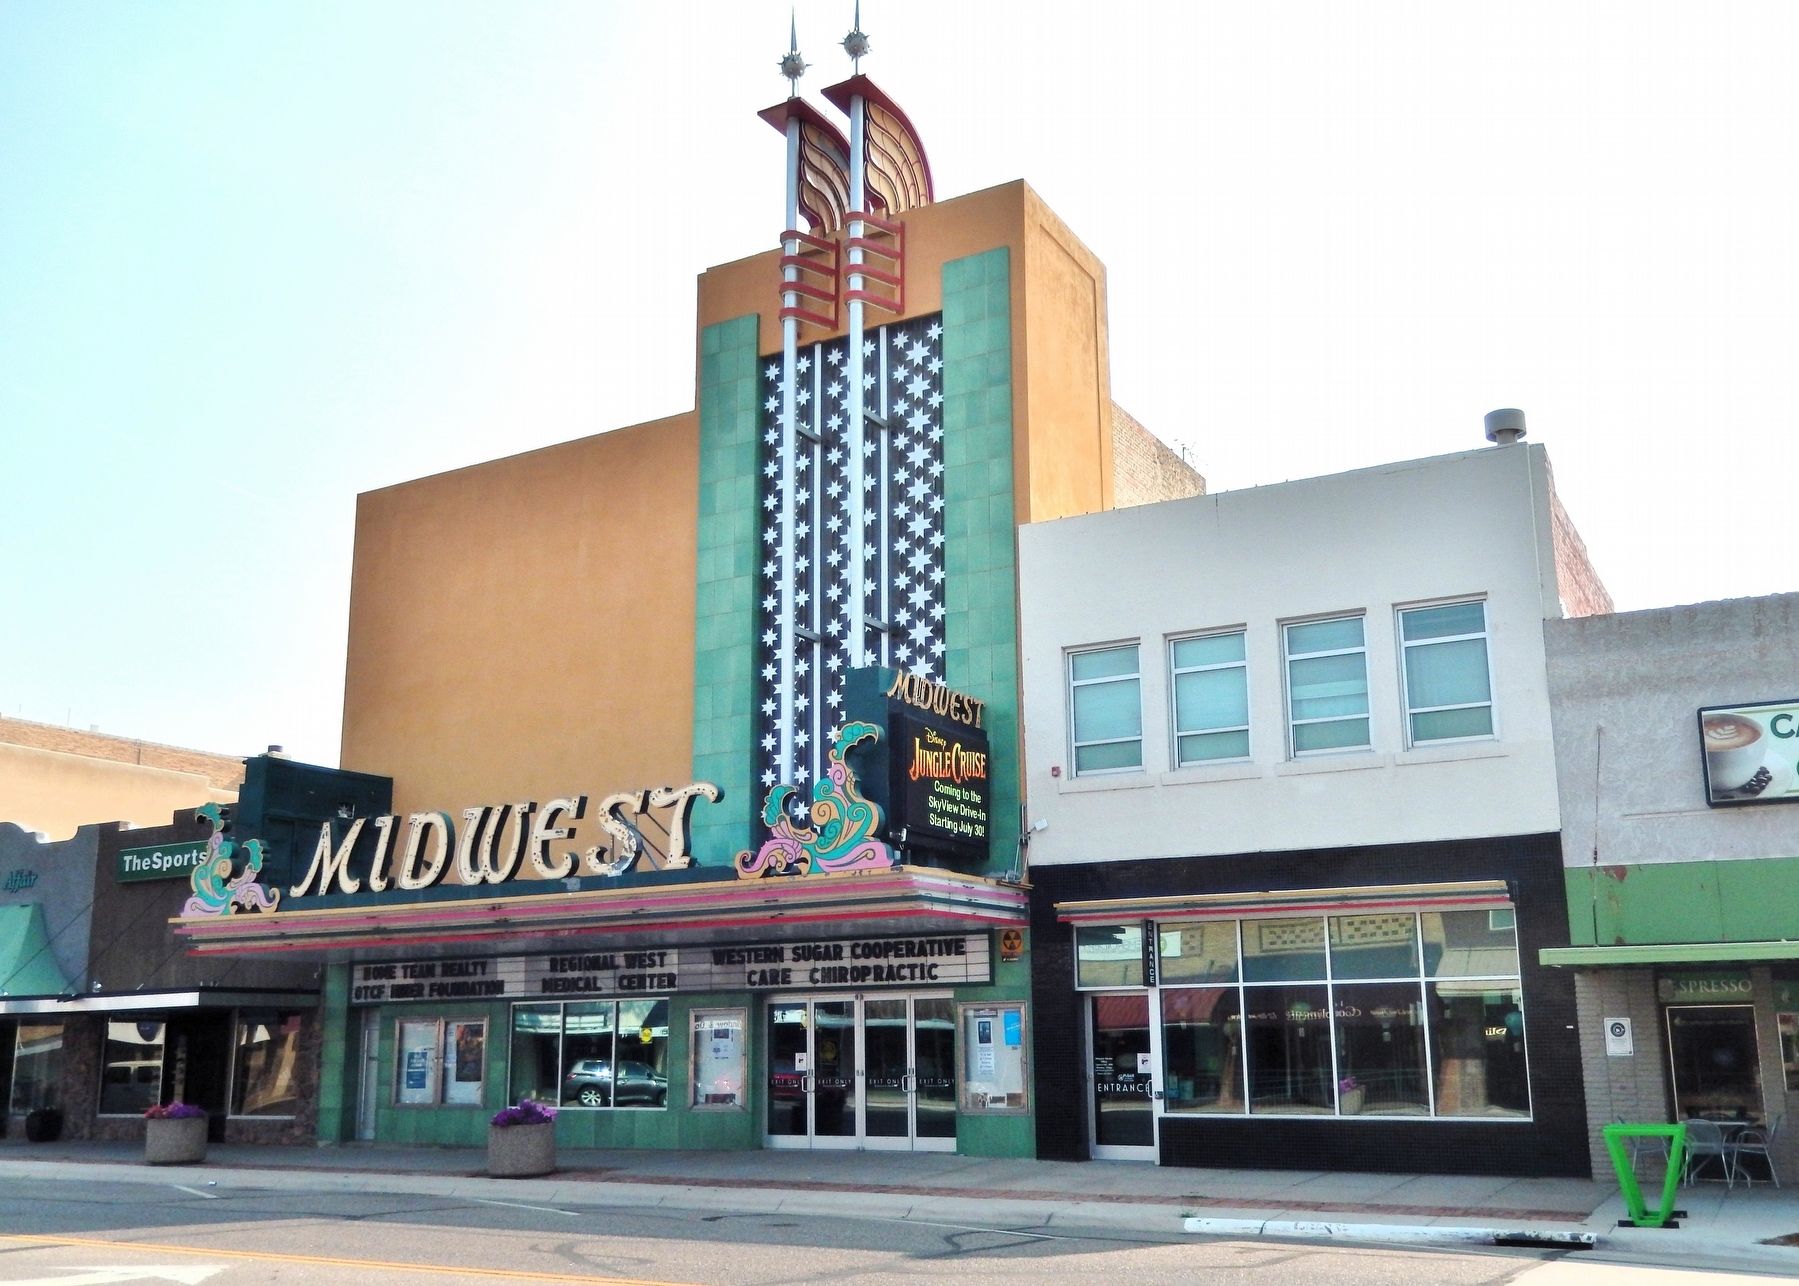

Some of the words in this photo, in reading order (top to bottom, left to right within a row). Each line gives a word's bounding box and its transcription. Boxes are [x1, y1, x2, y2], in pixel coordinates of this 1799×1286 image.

[887, 669, 986, 728] MIDWEST
[1770, 713, 1799, 739] C
[925, 727, 947, 751] Disney
[909, 737, 952, 781] JUNGLE
[951, 742, 987, 784] CRUISE
[934, 780, 961, 801] Coming
[962, 789, 969, 800] to
[970, 790, 982, 804] the
[928, 798, 959, 817] SkyView
[960, 804, 987, 822] Drive-In
[929, 813, 958, 833] Starting
[959, 819, 974, 836] July
[974, 823, 985, 838] 30!
[290, 781, 724, 897] MIDWEST
[3, 869, 38, 893] Affair
[549, 954, 619, 973] REGIONAL
[624, 951, 667, 969] WEST
[712, 946, 784, 965] WESTERN
[791, 943, 843, 962] SUGAR
[851, 938, 966, 959] COOPERATIVE
[1147, 922, 1155, 983] ENTRANCE
[363, 965, 396, 981] HOME
[401, 963, 436, 979] TEAM
[441, 961, 488, 977] REALTY
[541, 976, 602, 993] MEDICAL
[618, 973, 677, 990] CENTER
[747, 968, 792, 986] CARE
[809, 962, 939, 984] CHIROPRACTIC
[429, 980, 504, 997] FOUNDATION
[1673, 979, 1753, 993] SPRESSO
